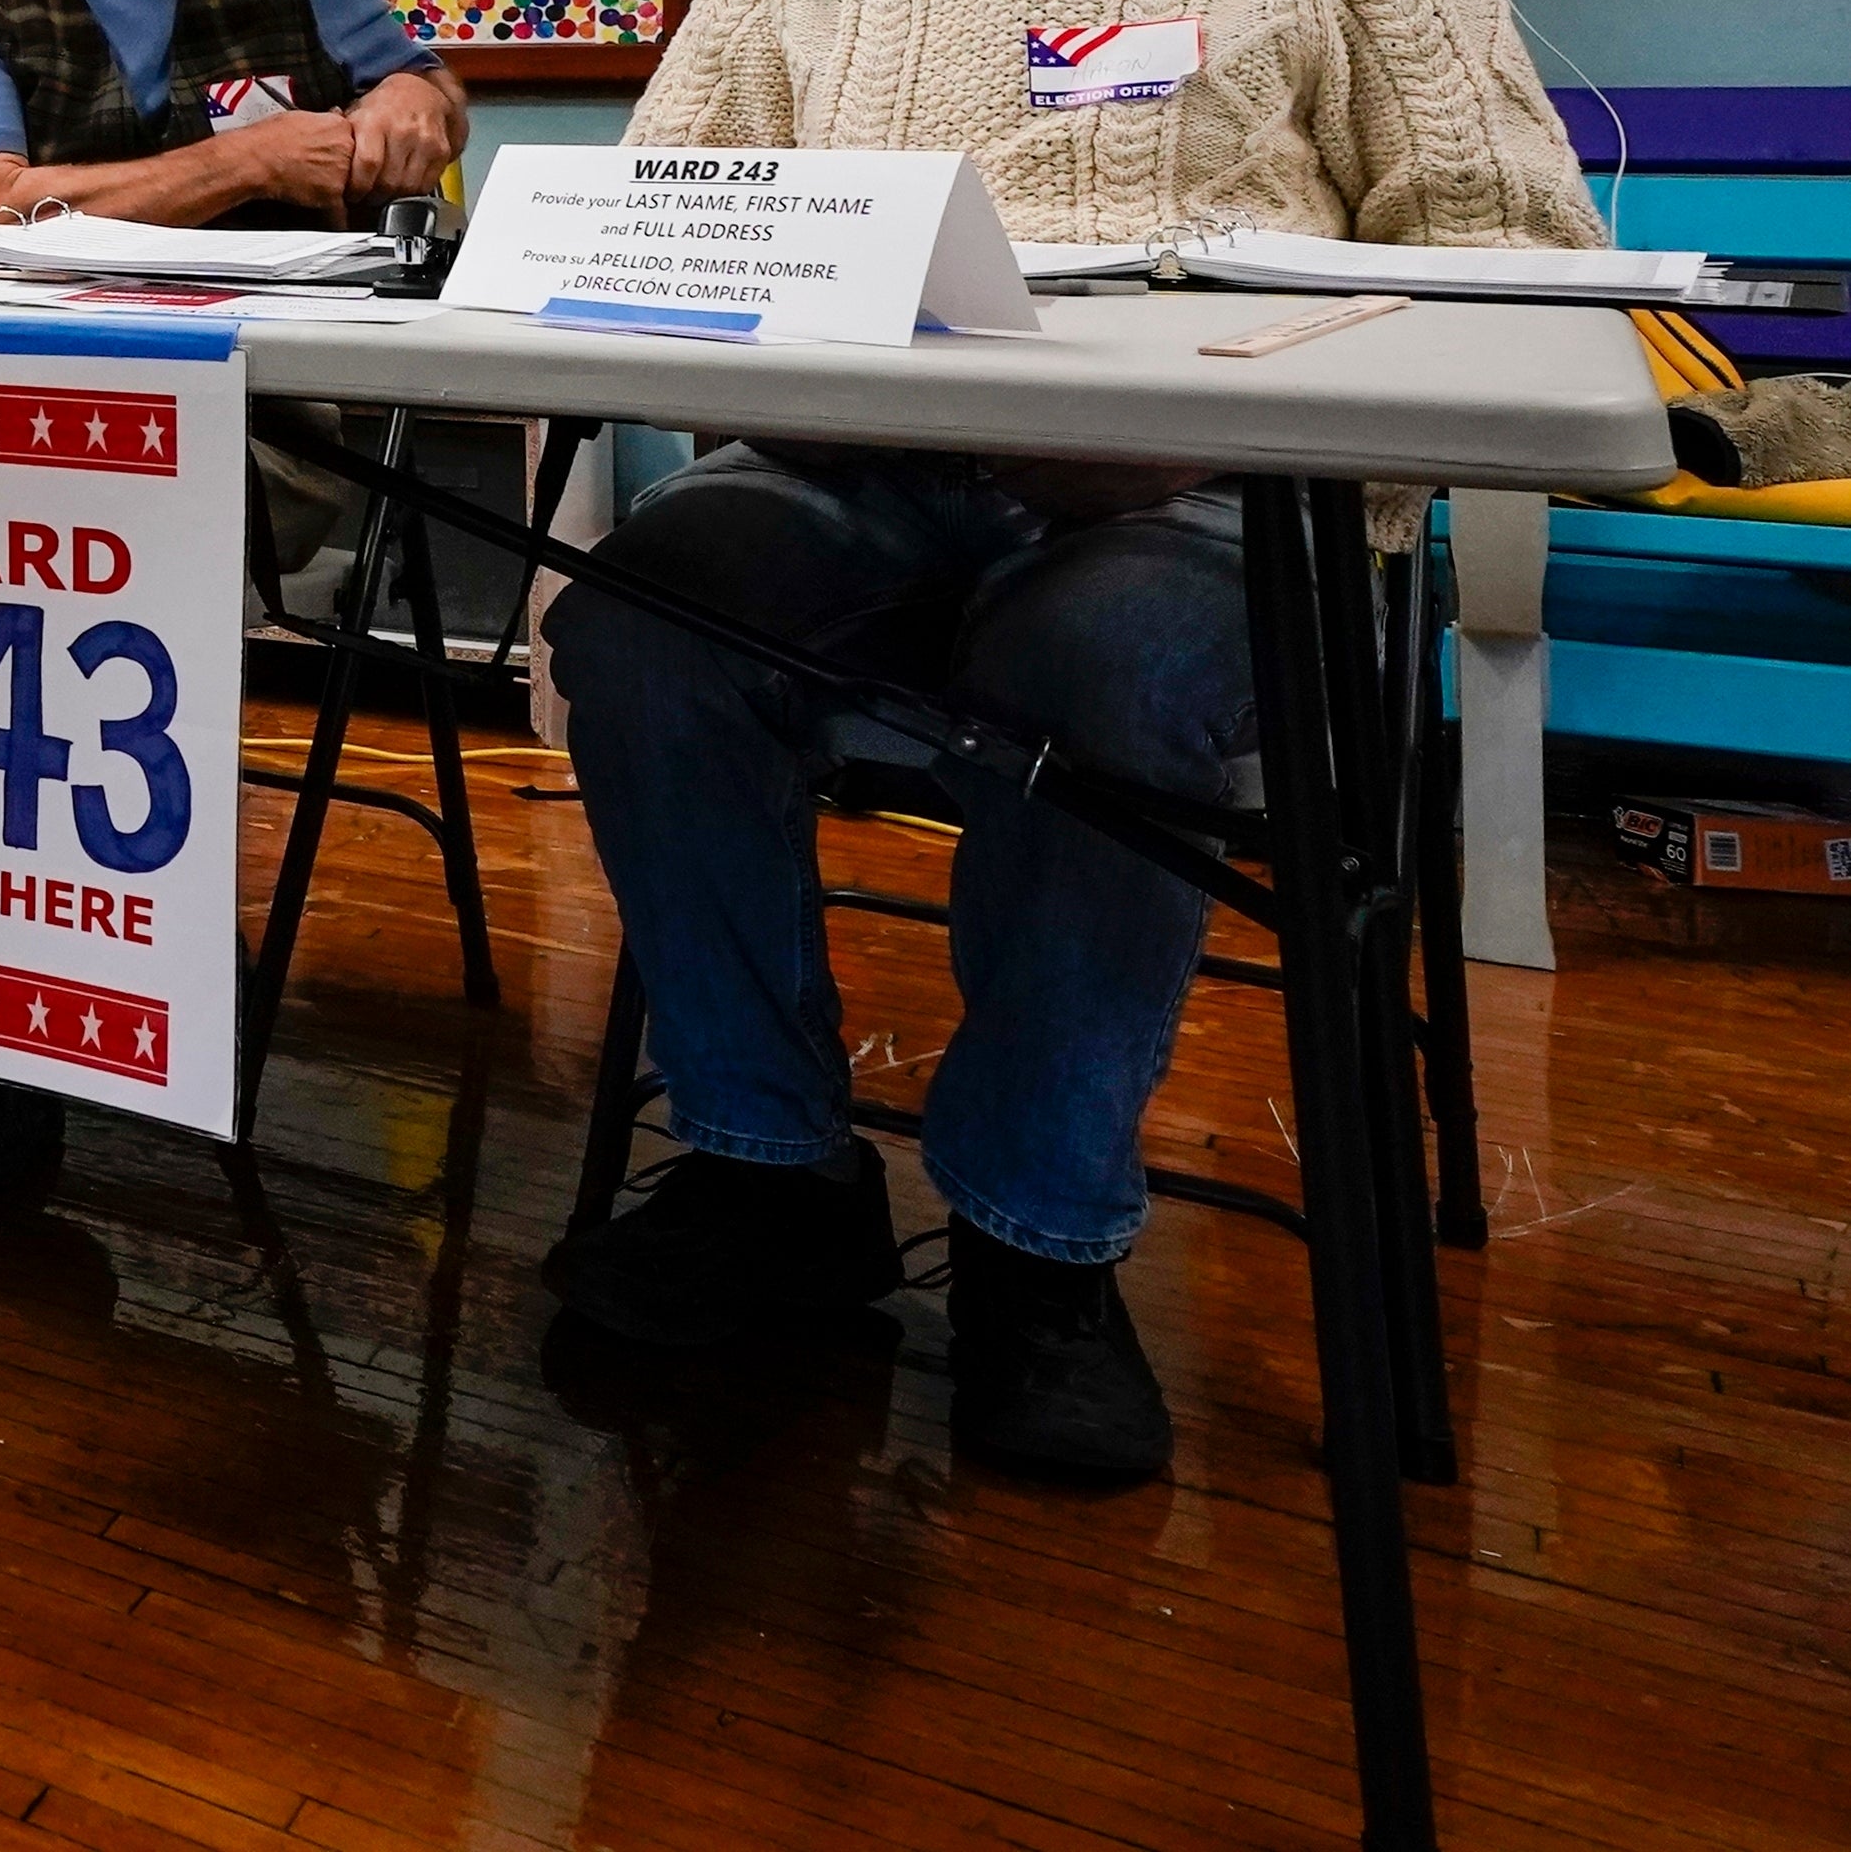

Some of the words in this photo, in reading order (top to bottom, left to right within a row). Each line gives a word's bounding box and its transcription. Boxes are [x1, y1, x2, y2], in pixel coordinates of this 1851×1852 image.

[1035, 88, 1115, 106] ELECTION
[633, 158, 721, 181] WARD
[727, 160, 780, 182] 243
[531, 190, 585, 207] Provide
[589, 198, 622, 211] your
[625, 192, 671, 211] LAST
[675, 194, 739, 214] NAME,
[745, 195, 802, 214] FIRST
[807, 197, 873, 216] NAME
[600, 222, 629, 237] and
[633, 220, 675, 239] FULL
[681, 222, 774, 242] ADDRESS
[522, 249, 567, 265] Provea
[570, 256, 585, 266] su
[587, 251, 675, 274] APELLIDO,
[681, 257, 750, 277] PRIMER
[753, 260, 840, 282] NOMBRE,
[561, 276, 570, 291] y
[574, 274, 670, 296] DIRECCIÓN
[675, 280, 776, 304] COMPLETA.
[1626, 812, 1659, 834] BIC
[1666, 844, 1686, 861] 60
[0, 870, 155, 946] HERE
